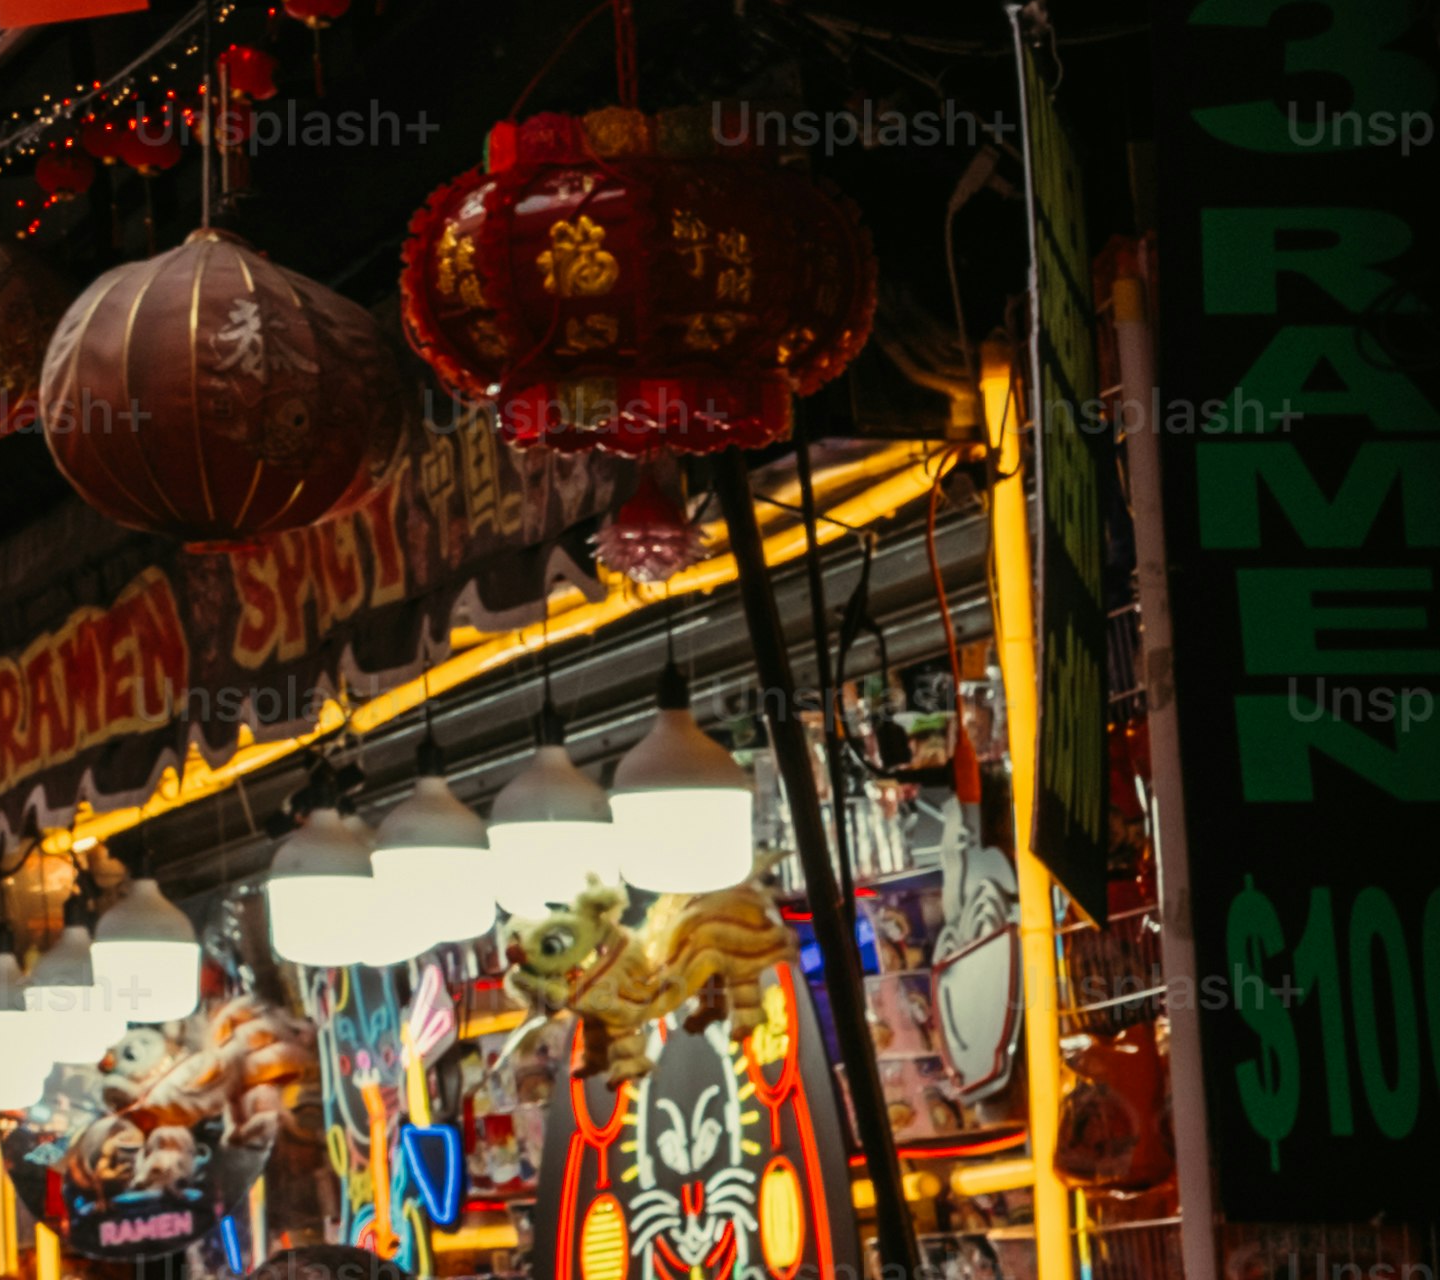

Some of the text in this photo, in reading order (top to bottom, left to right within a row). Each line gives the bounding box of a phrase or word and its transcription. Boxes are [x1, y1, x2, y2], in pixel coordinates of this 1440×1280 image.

[1194, 206, 1440, 803] RAMEN
[1224, 872, 1440, 1176] $10
[99, 1209, 194, 1249] RAMEN
